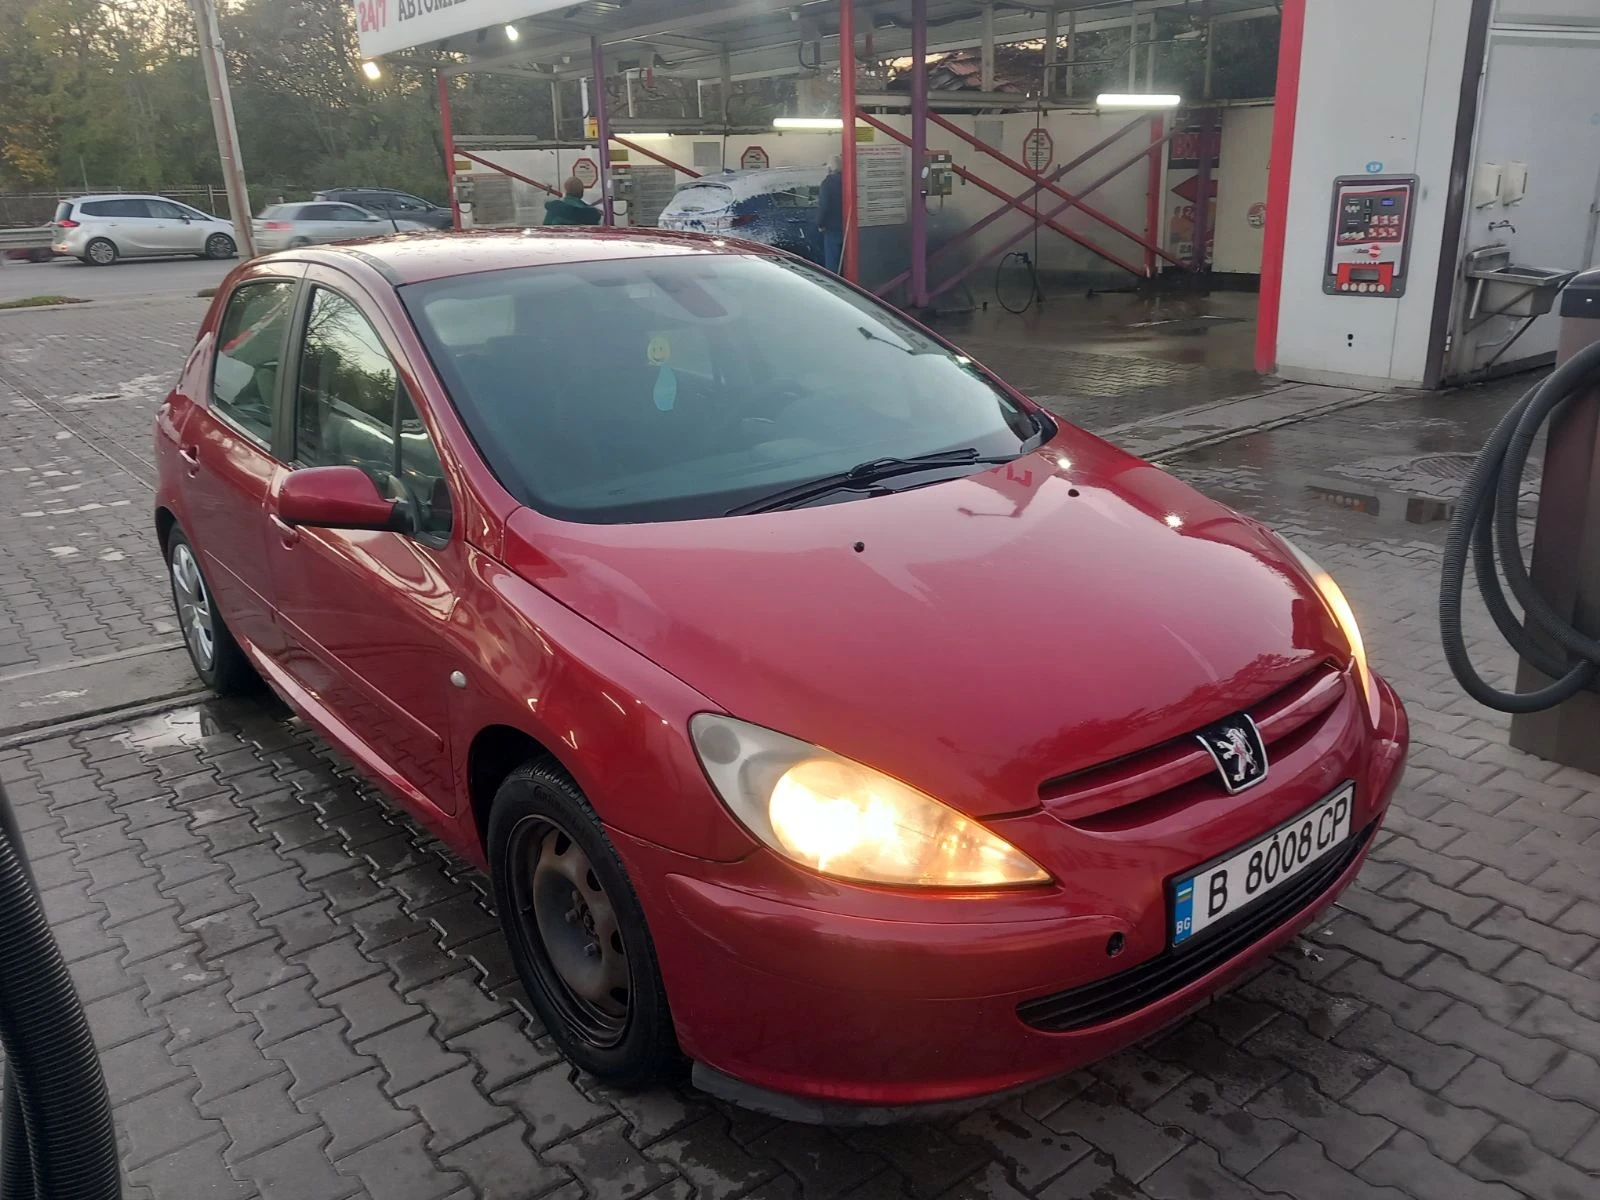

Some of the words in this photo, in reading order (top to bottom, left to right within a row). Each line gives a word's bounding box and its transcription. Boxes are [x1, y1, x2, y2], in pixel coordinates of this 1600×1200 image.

[358, 0, 387, 32] 24/7
[1208, 869, 1228, 918] B
[1246, 820, 1312, 895] 8008
[1317, 797, 1348, 850] CP
[1176, 916, 1191, 935] BG
